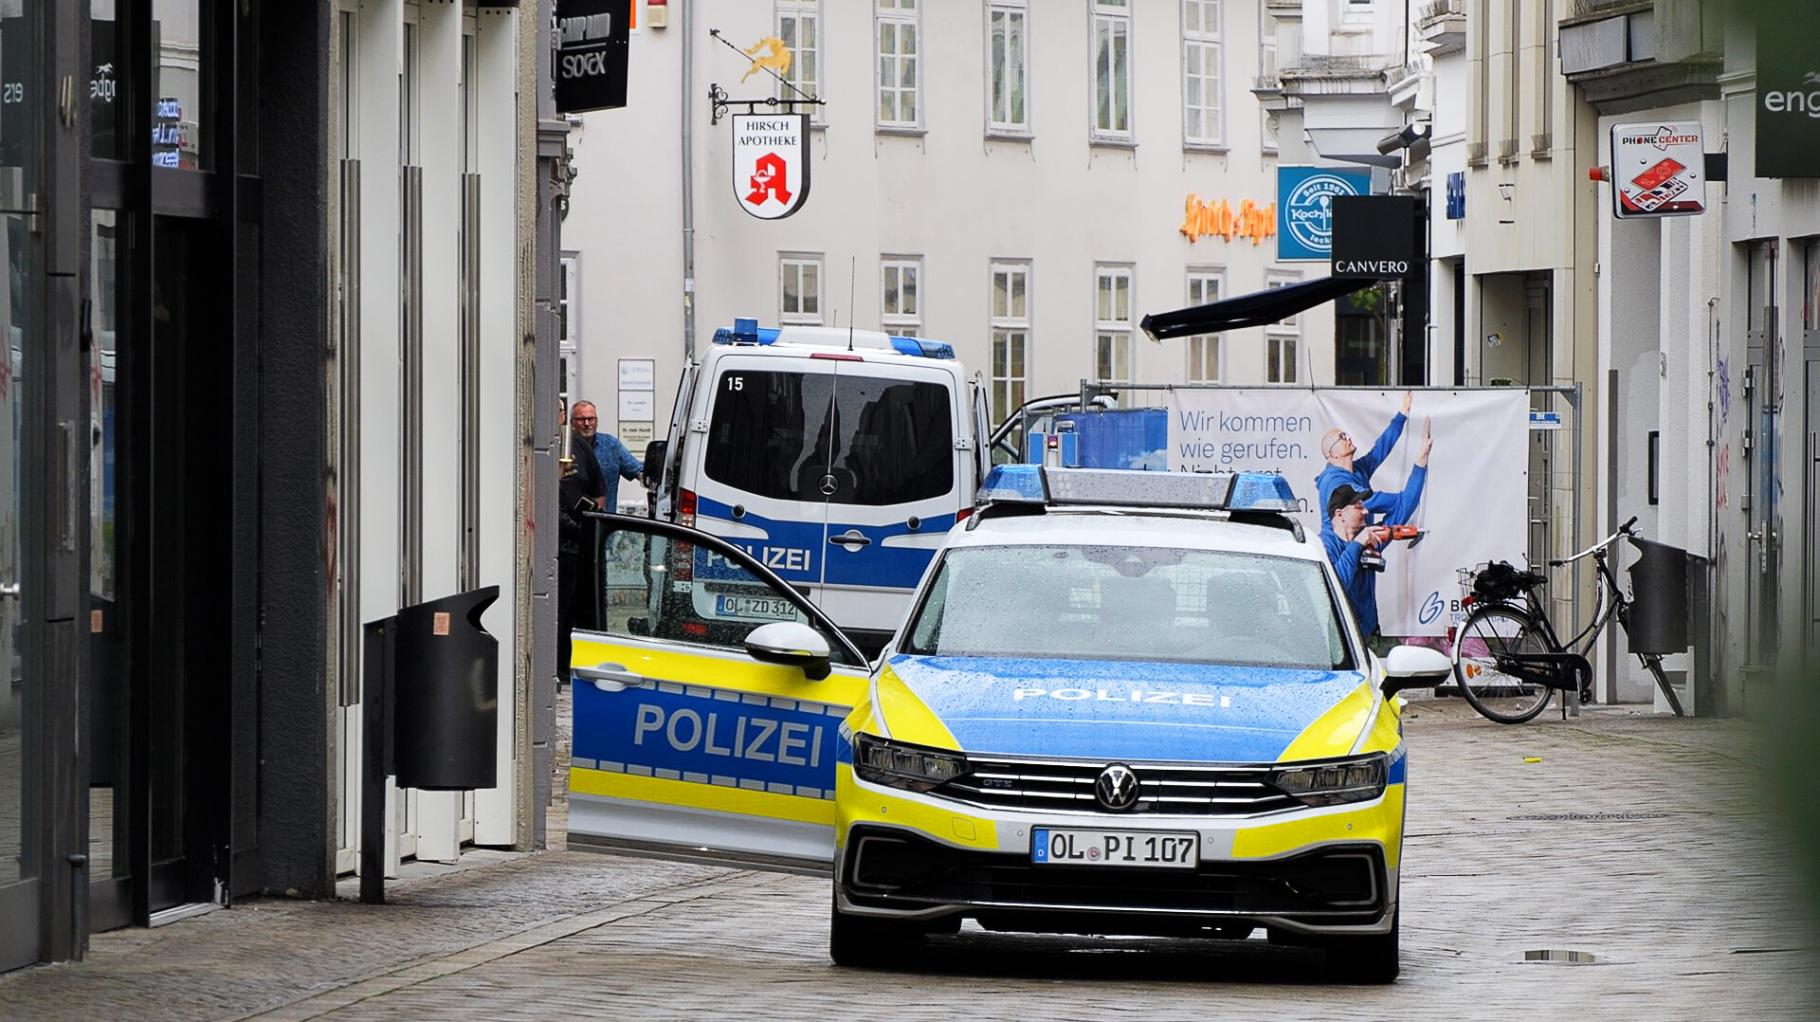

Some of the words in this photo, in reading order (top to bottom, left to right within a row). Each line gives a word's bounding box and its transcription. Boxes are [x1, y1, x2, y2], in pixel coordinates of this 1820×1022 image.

[1764, 90, 1820, 118] eng
[746, 121, 789, 131] HIRSCH
[739, 136, 797, 146] APOTHEKE
[1622, 136, 1657, 145] PHONE
[1658, 134, 1698, 144] CENTER
[1303, 183, 1321, 197] Seit
[1335, 260, 1408, 273] CANVERO
[727, 376, 743, 391] 15
[1180, 410, 1214, 432] Wir
[1219, 410, 1311, 432] kommen
[1180, 438, 1214, 459] wie
[1220, 438, 1307, 464] gerufen.
[725, 598, 743, 612] OL
[752, 600, 769, 613] ZD
[771, 600, 795, 615] 312
[1013, 688, 1231, 708] POLIZEI
[634, 703, 823, 768] POLIZEI
[1051, 833, 1084, 859] OL
[1104, 835, 1136, 861] PI
[1144, 837, 1194, 863] 107
